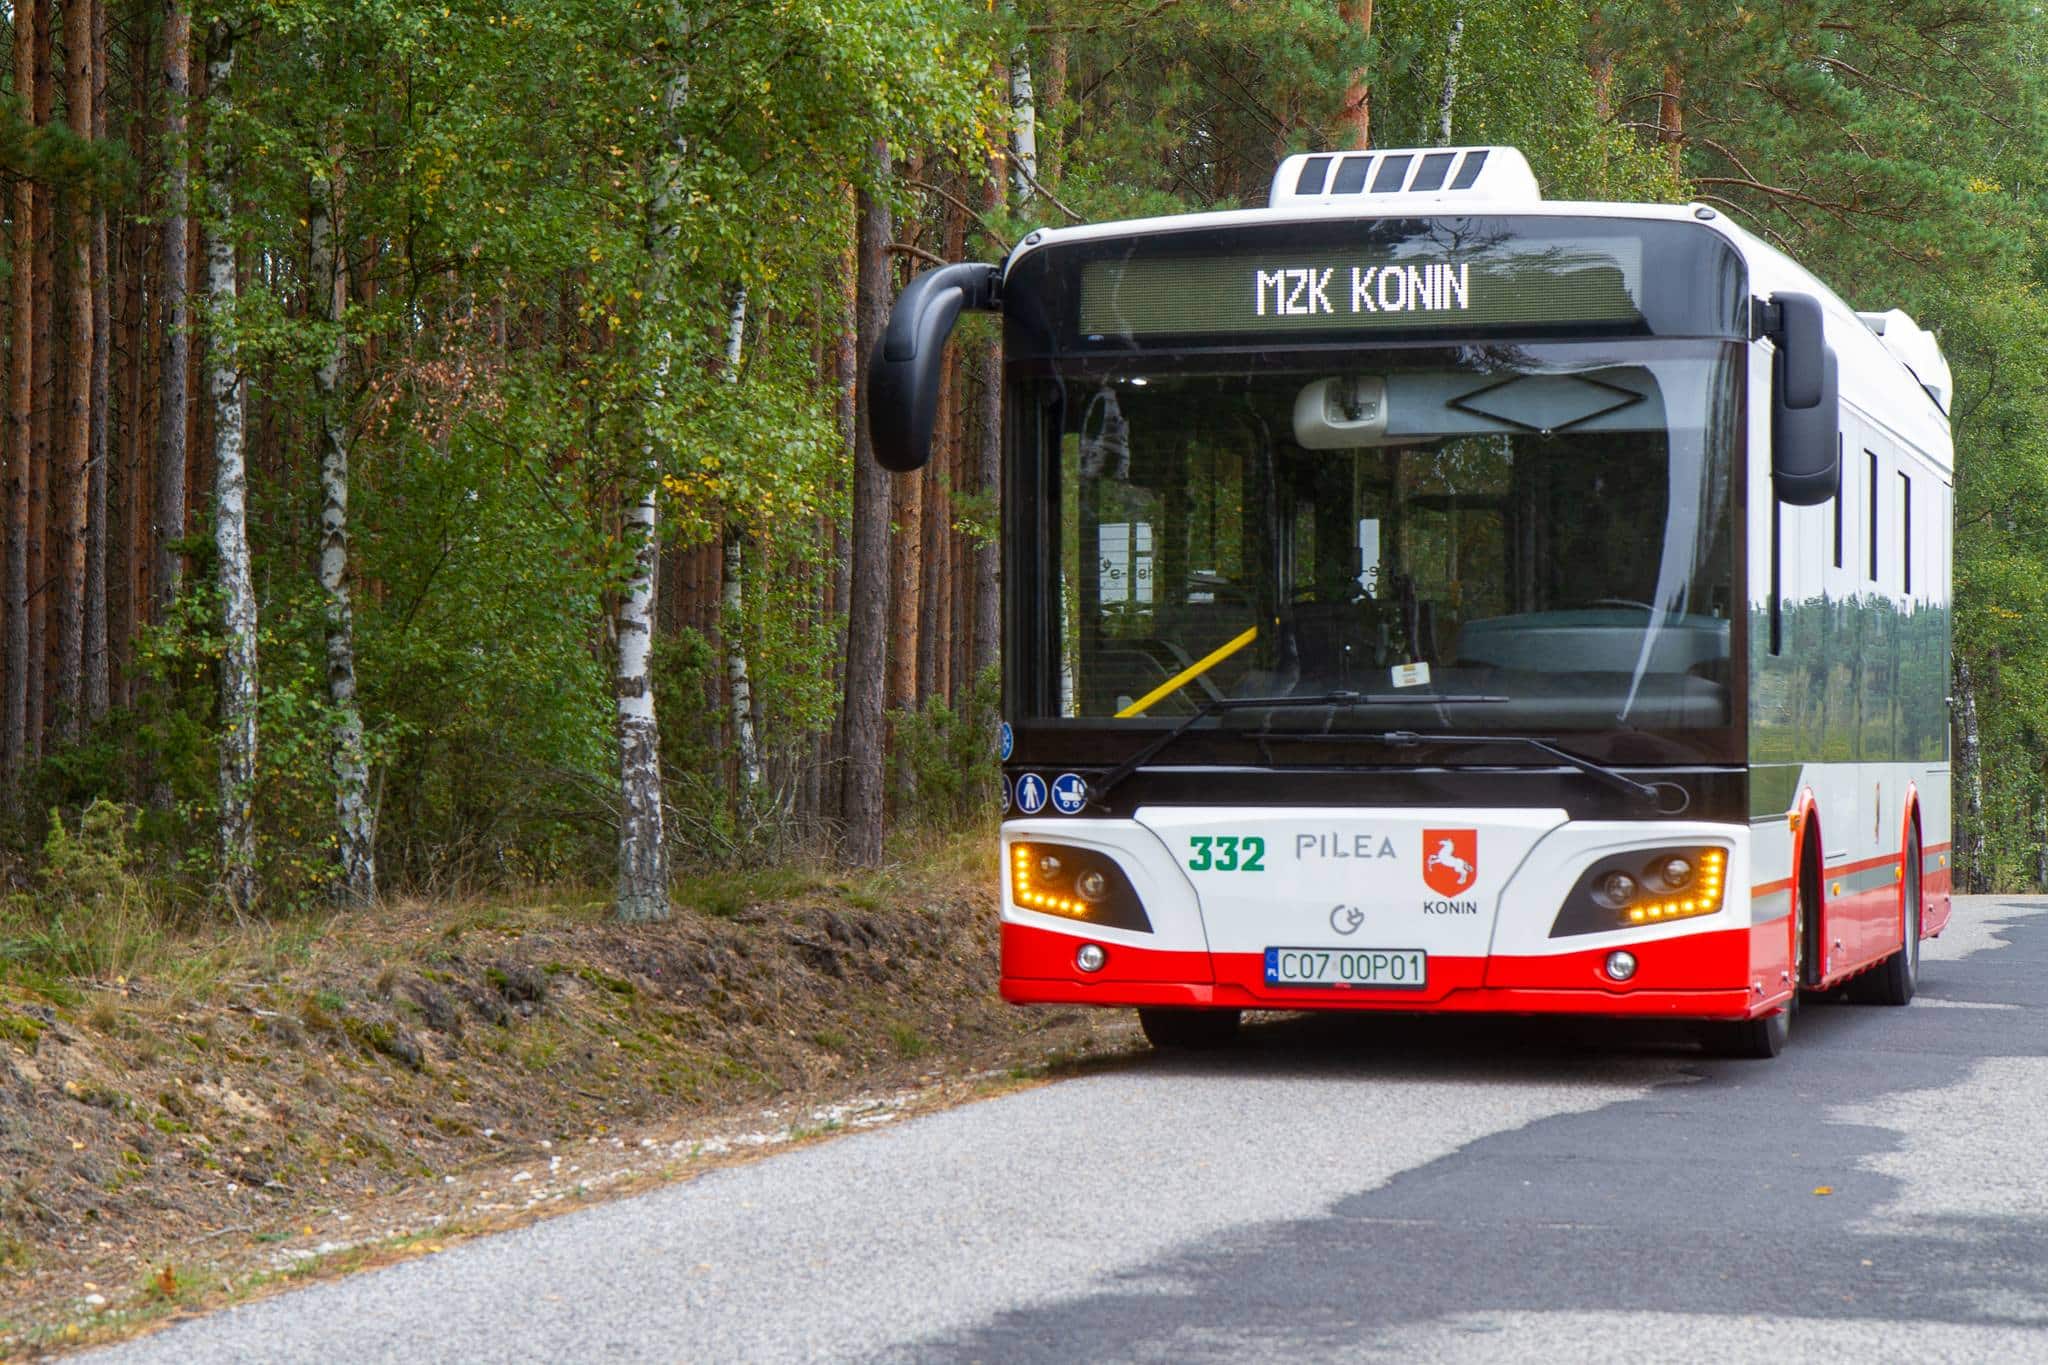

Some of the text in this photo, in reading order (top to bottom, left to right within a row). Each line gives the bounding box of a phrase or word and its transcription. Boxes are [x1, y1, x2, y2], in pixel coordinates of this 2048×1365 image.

[1256, 263, 1469, 316] MZK KONIN
[1188, 836, 1266, 872] 332
[1295, 832, 1398, 860] PILEA
[1422, 901, 1478, 915] KONIN
